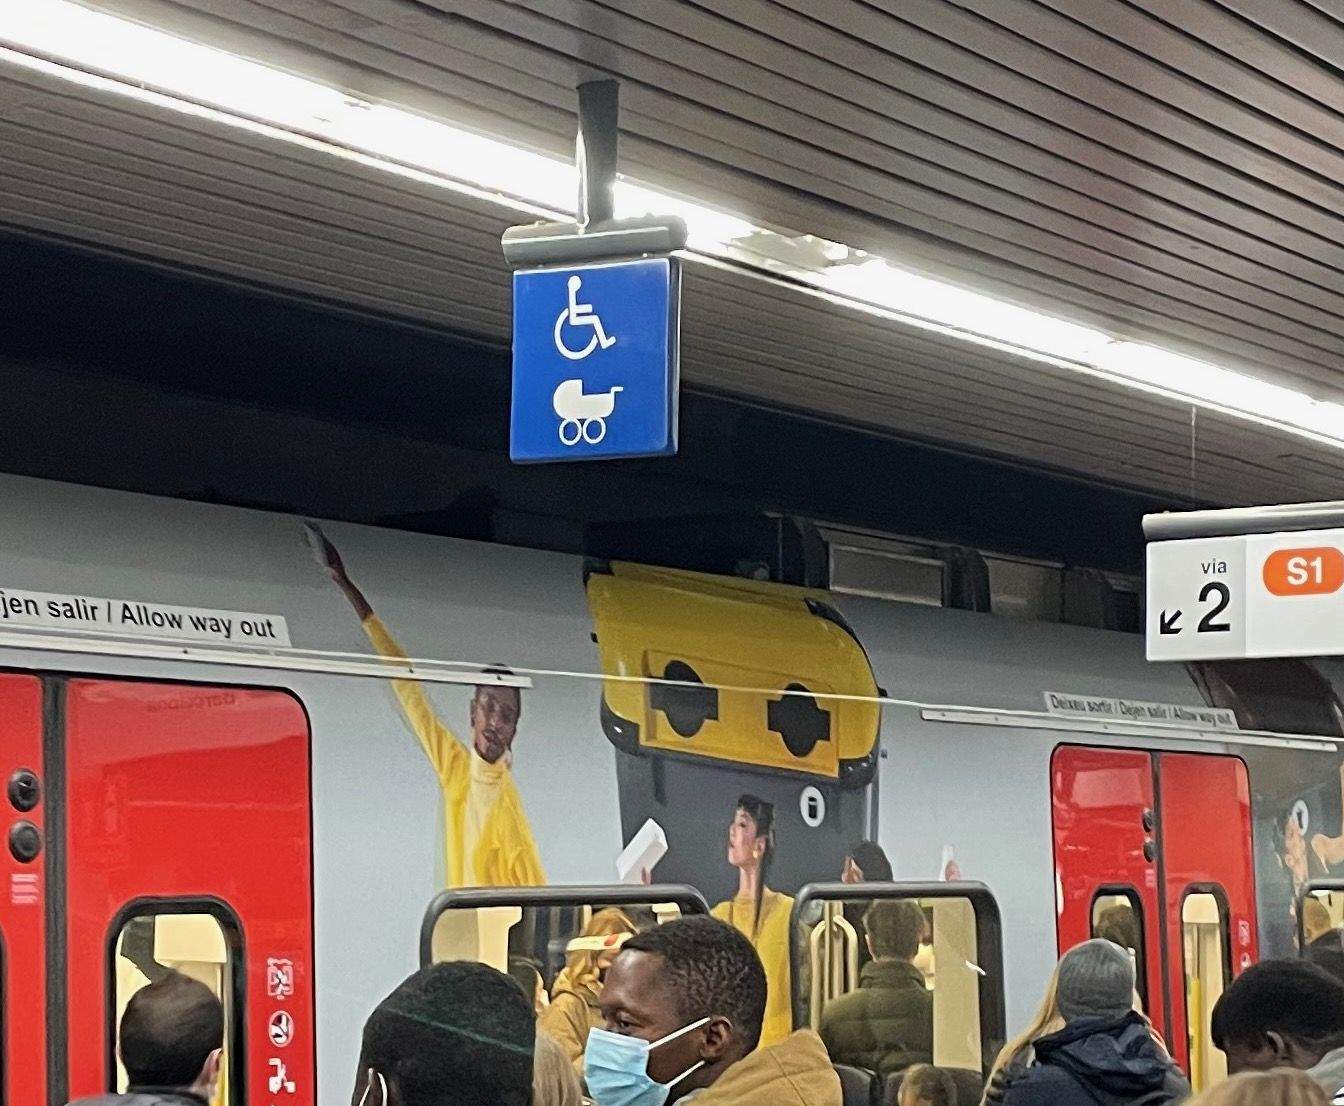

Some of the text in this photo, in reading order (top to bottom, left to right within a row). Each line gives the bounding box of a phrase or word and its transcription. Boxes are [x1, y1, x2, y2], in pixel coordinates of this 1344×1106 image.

[1201, 558, 1228, 574] via
[1286, 556, 1324, 586] S1
[47, 598, 98, 621] salir
[121, 603, 183, 630] Allow
[189, 614, 233, 638] way
[240, 617, 276, 638] out
[1197, 581, 1232, 634] 2
